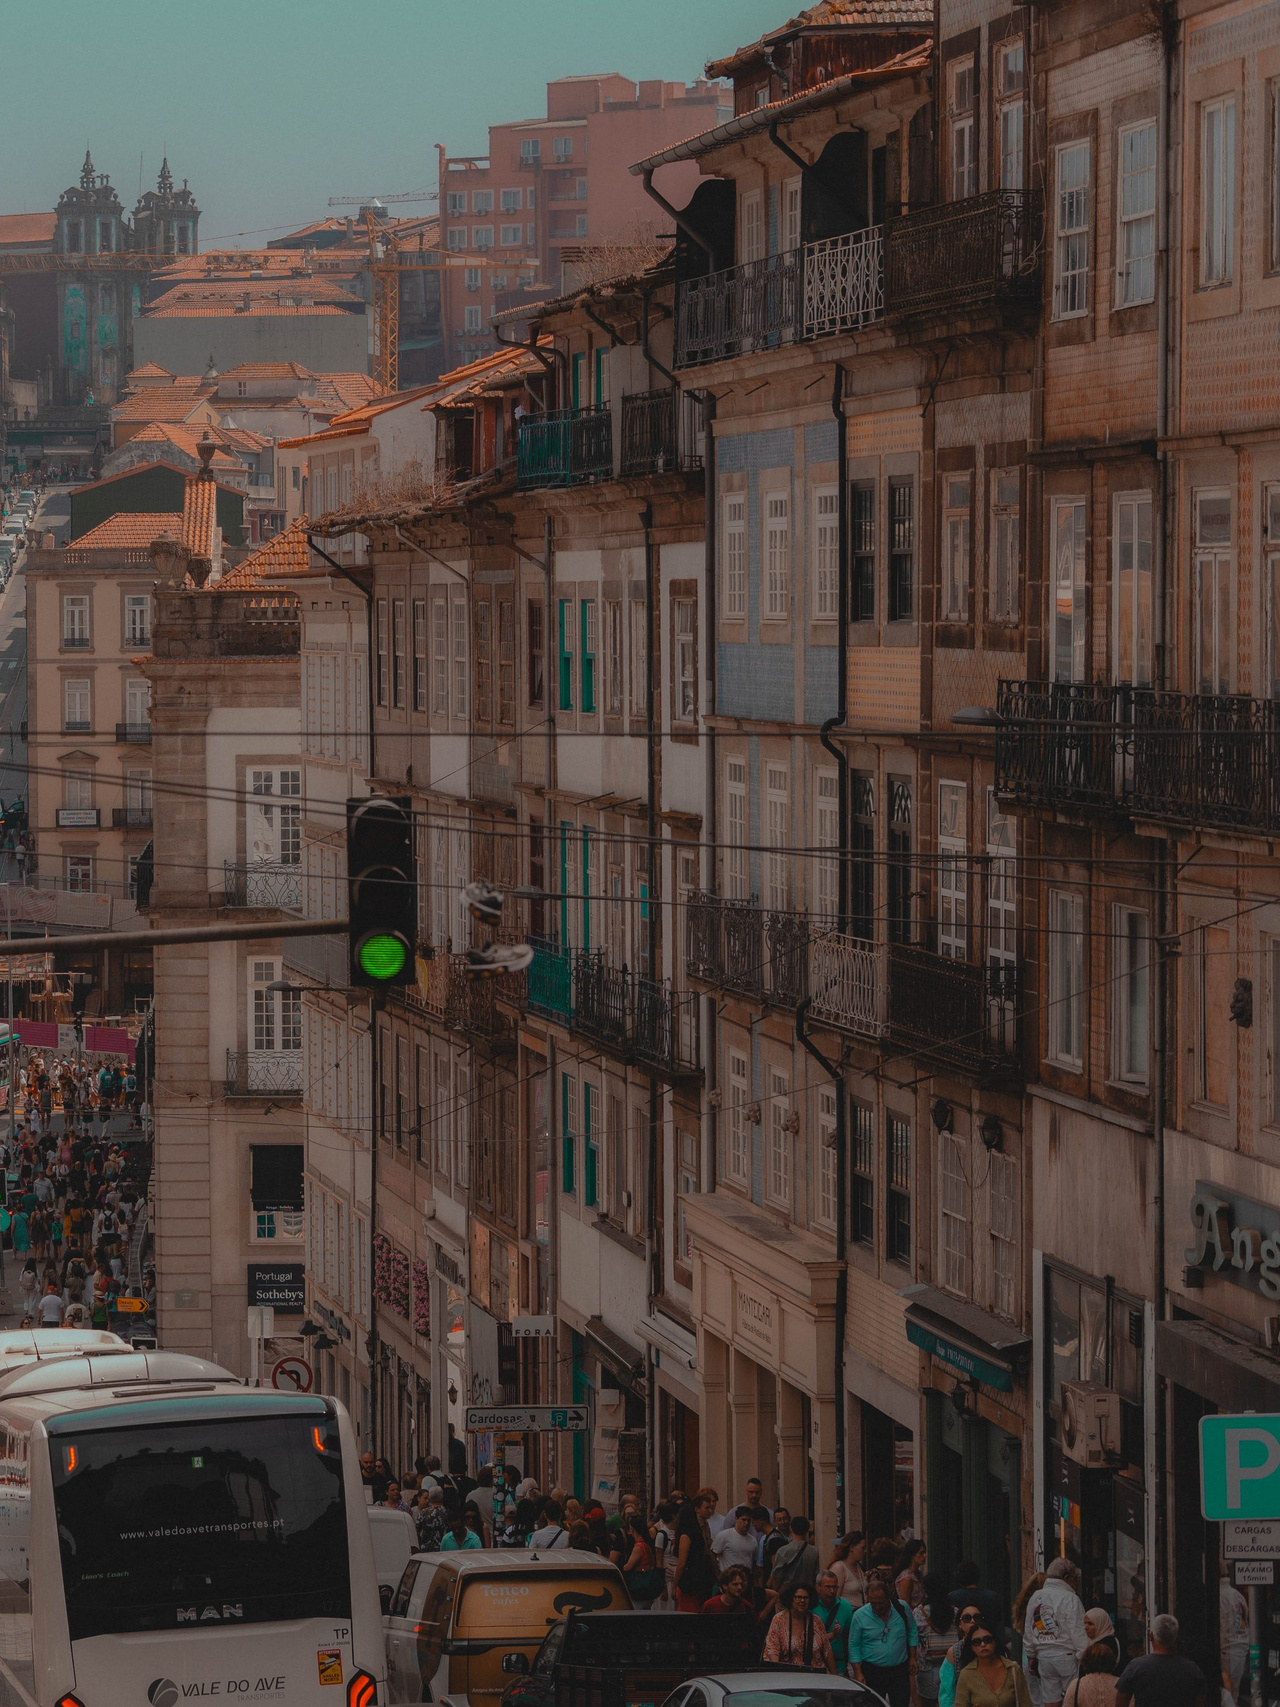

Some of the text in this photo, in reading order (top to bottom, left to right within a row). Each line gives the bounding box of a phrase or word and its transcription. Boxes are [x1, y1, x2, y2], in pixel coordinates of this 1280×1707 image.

[255, 1271, 293, 1283] Portugal
[255, 1289, 304, 1301] Sotheby's
[515, 1329, 552, 1337] FORA
[469, 1414, 523, 1424] Cardosas
[1225, 1428, 1280, 1509] P
[119, 1517, 286, 1541] www.valedoavetransportes.pt
[1234, 1526, 1272, 1535] CARGAS
[1251, 1537, 1258, 1545] E
[1225, 1545, 1280, 1554] DESCARGAS
[1236, 1562, 1273, 1574] MÁXIMO
[81, 1570, 130, 1580] Lion's Coach
[1242, 1575, 1267, 1583] 15min
[480, 1584, 530, 1597] Tenco
[176, 1603, 244, 1622] MAN
[333, 1628, 349, 1640] TP
[180, 1675, 287, 1698] VALE DO AVE
[236, 1691, 287, 1704] TRANSPORTES
